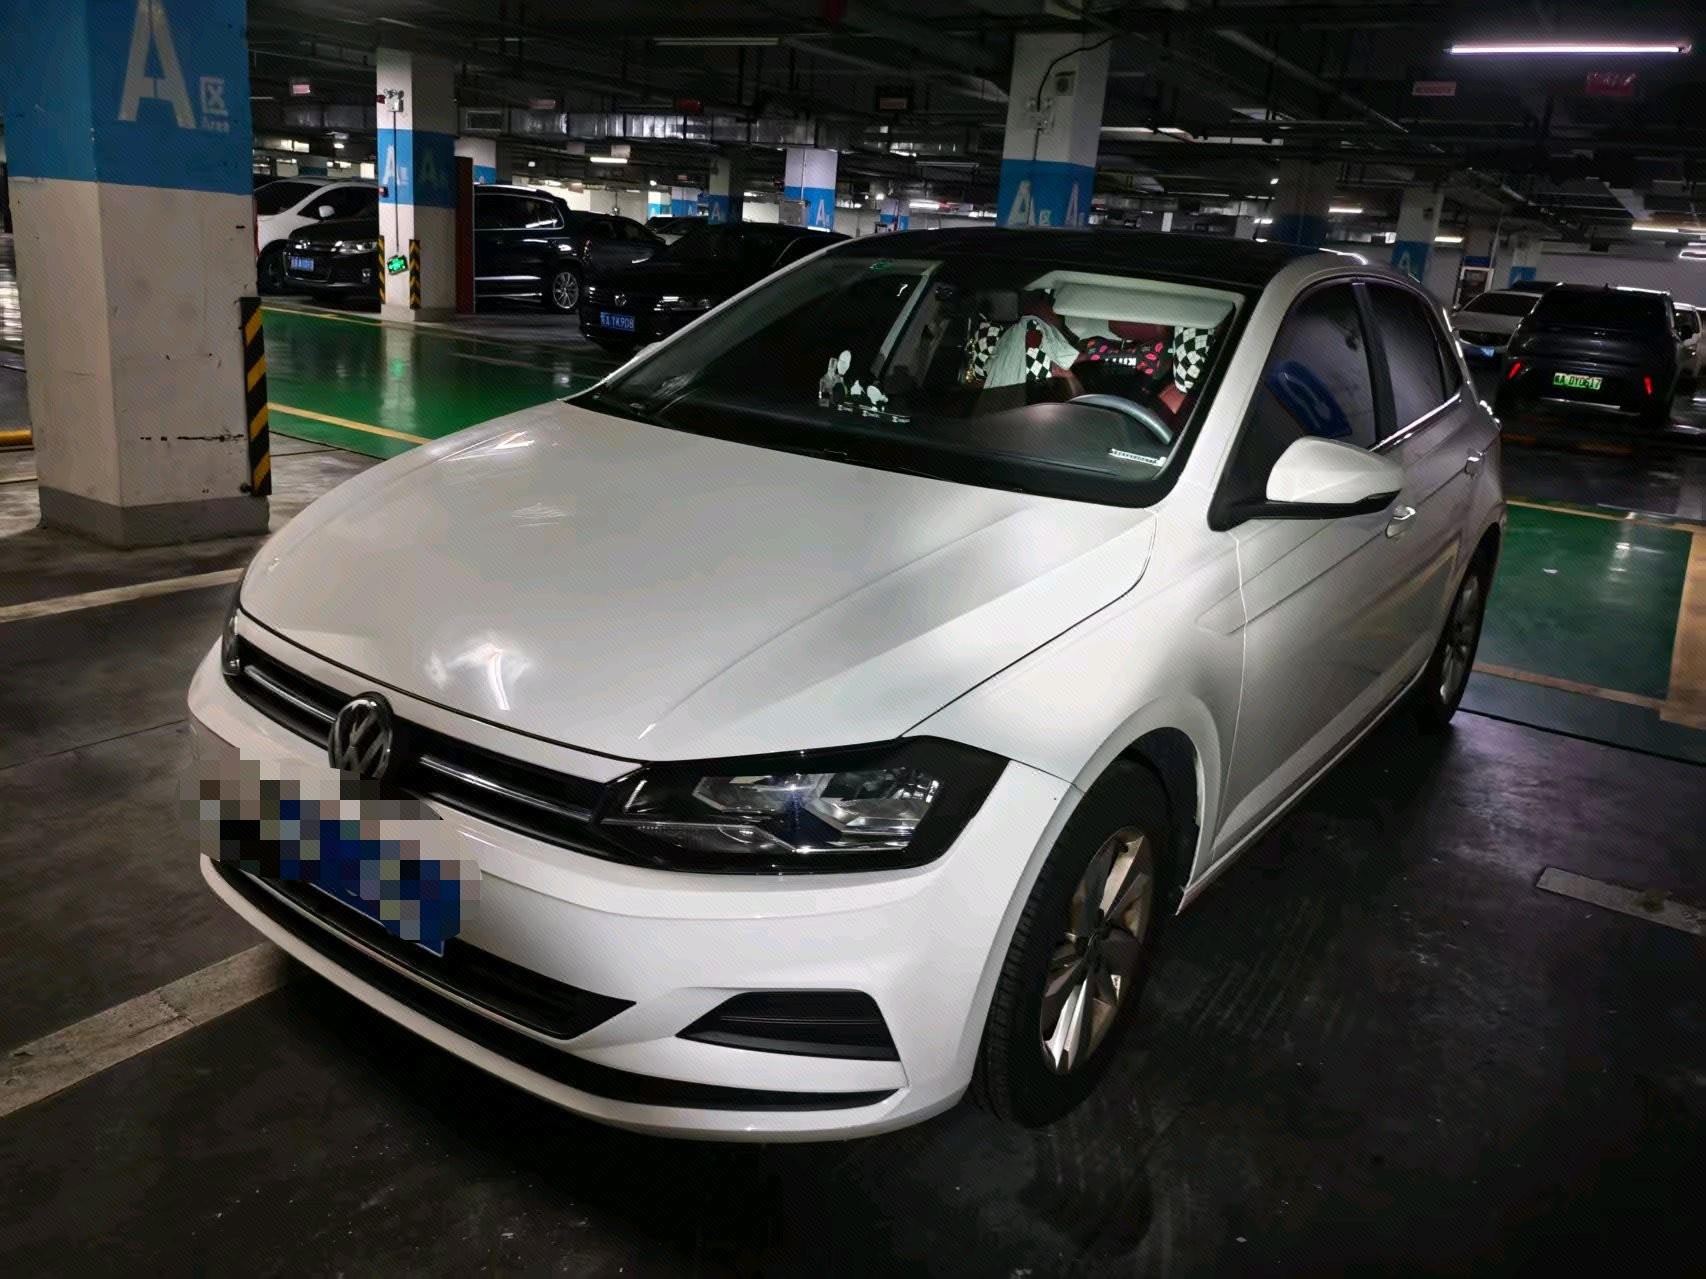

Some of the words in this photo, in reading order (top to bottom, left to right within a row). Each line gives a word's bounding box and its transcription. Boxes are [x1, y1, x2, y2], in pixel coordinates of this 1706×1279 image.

[382, 145, 401, 186] A
[815, 199, 826, 228] A
[1006, 180, 1036, 226] A
